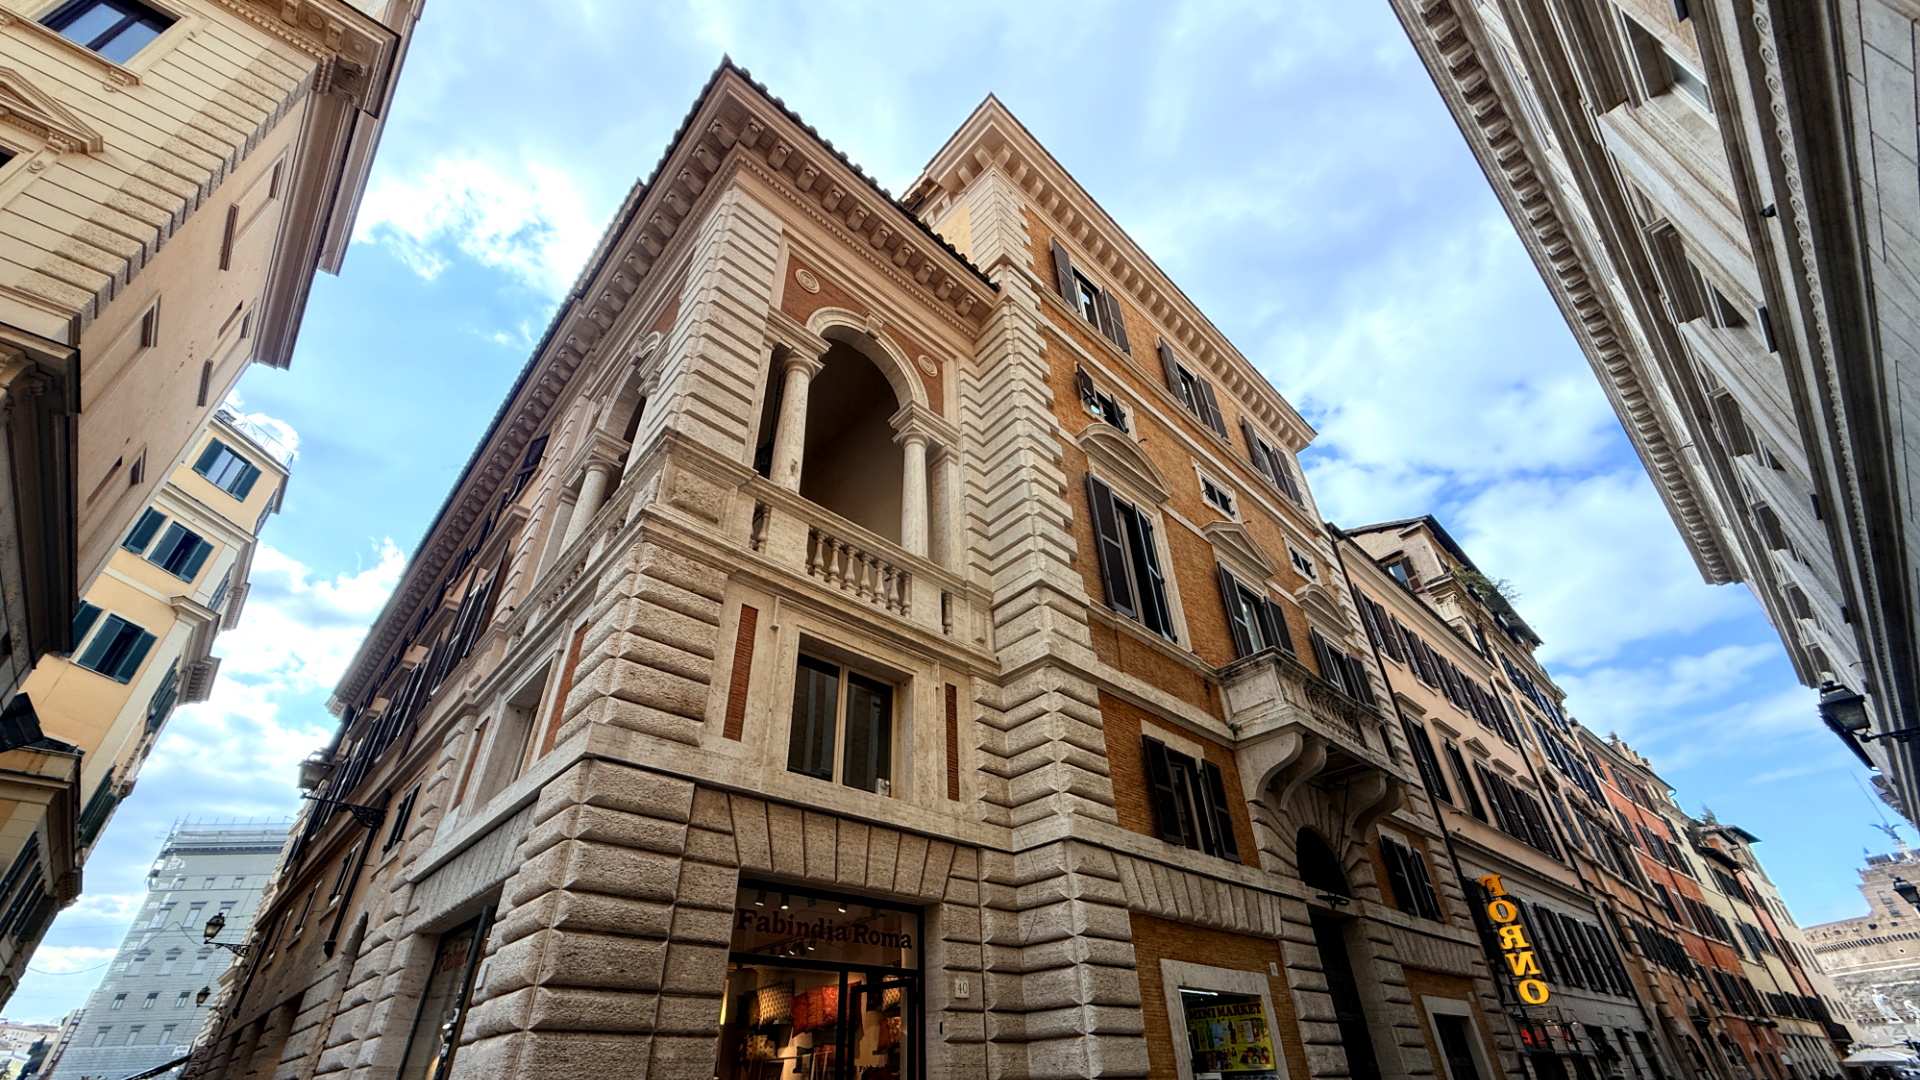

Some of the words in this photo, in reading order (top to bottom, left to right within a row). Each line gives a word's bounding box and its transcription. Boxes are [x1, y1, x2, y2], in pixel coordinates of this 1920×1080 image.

[735, 908, 849, 942] Fabindia
[852, 923, 912, 949] Roma
[957, 982, 968, 994] 40
[1188, 1008, 1216, 1020] MINI
[1217, 1002, 1262, 1017] MARKET
